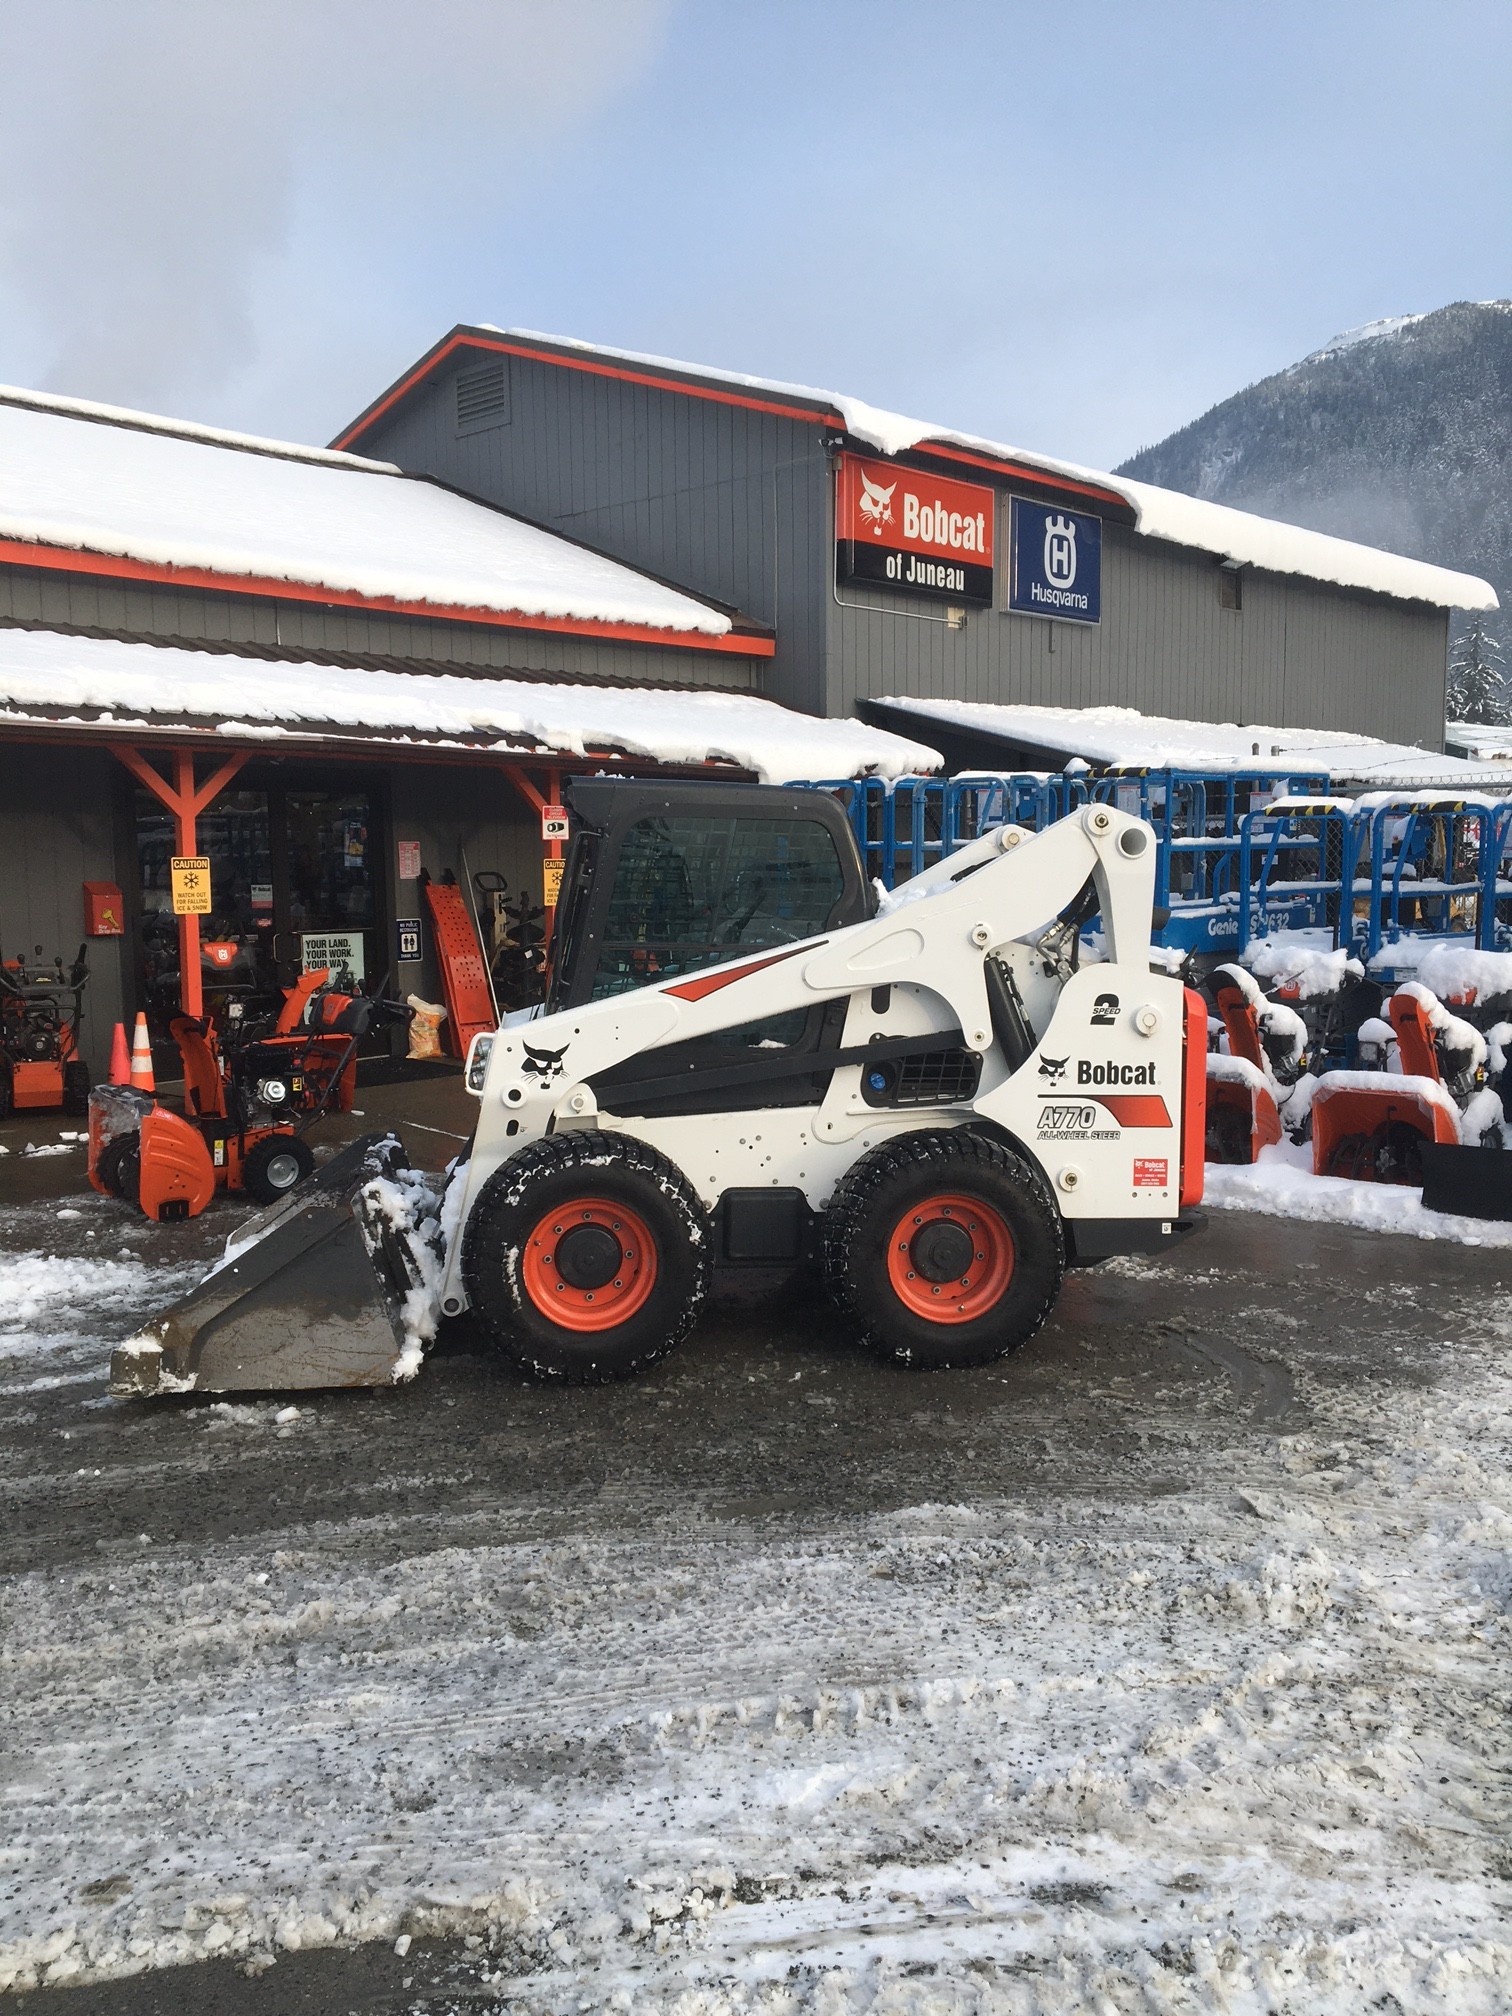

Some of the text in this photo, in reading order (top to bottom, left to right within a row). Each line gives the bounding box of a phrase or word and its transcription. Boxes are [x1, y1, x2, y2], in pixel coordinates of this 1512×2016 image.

[903, 492, 985, 553] Bobcat
[886, 554, 965, 591] of Juneau
[1031, 582, 1088, 609] Husqvarna
[173, 860, 208, 869] CAUTION
[545, 861, 566, 869] CAUTIO
[1208, 917, 1239, 936] Genie
[305, 939, 351, 949] YOUR LAND.
[306, 948, 354, 959] YOUR WORK.
[306, 960, 327, 969] YOUR
[1090, 993, 1120, 1025] 2
[1092, 1007, 1121, 1015] SPEED
[1077, 1060, 1156, 1085] Bobcat
[1037, 1106, 1096, 1129] A770
[1037, 1131, 1121, 1140] ALL-WHEEL STEER
